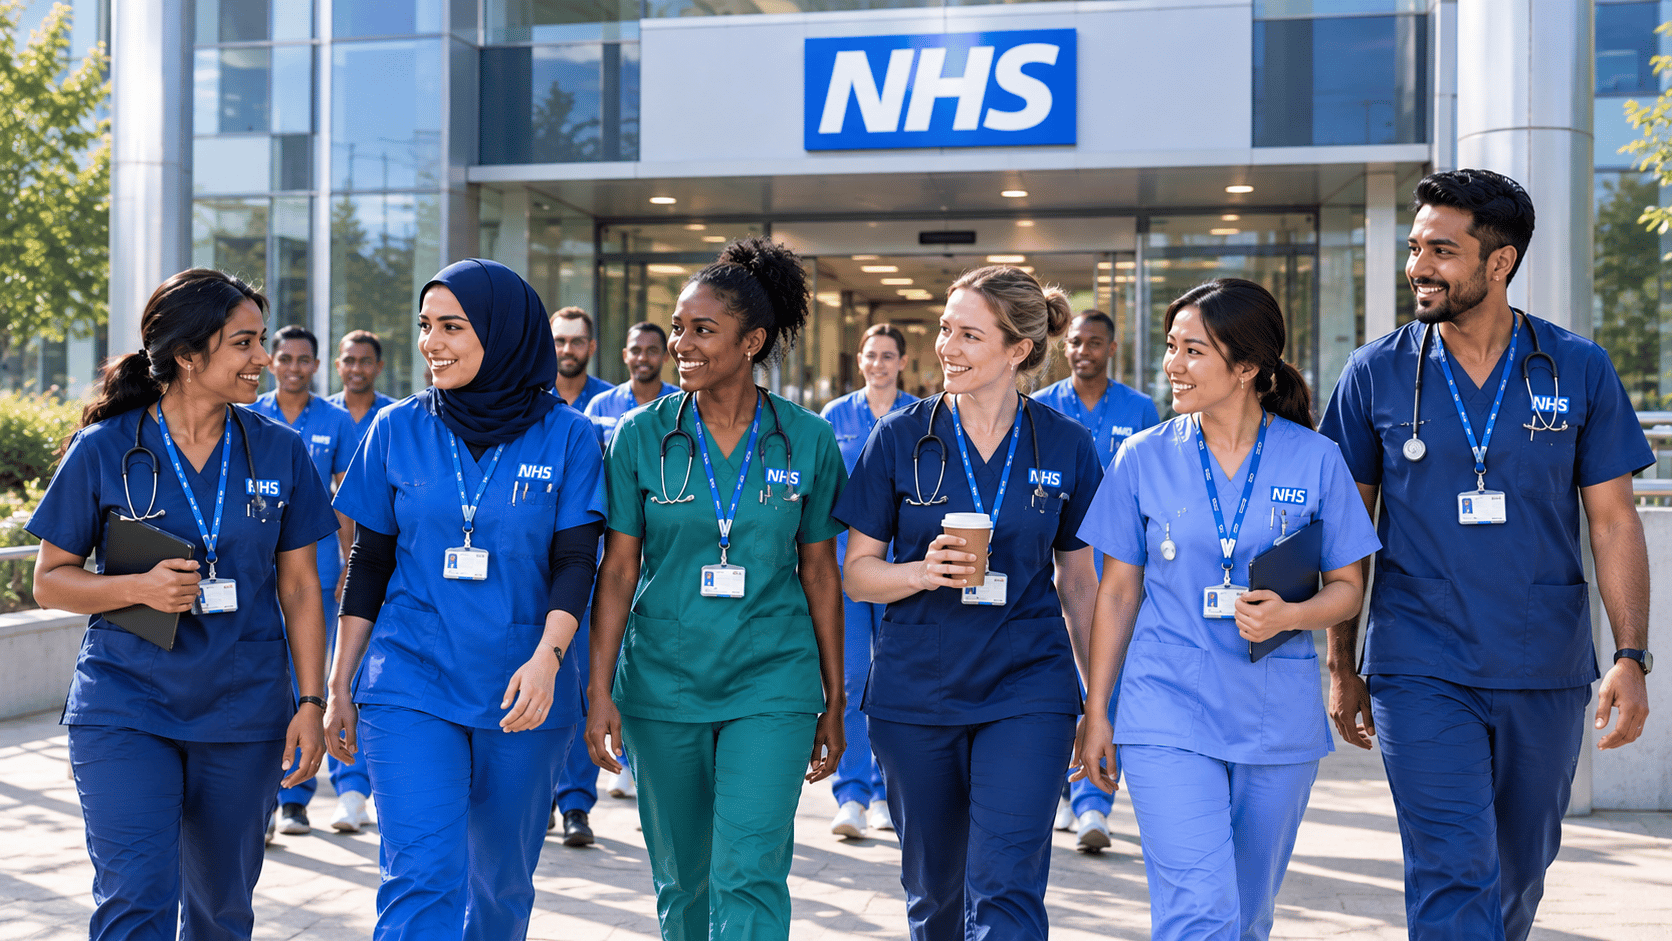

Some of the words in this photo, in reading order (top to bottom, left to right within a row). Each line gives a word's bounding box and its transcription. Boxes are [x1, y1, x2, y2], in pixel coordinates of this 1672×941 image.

[818, 42, 1060, 134] NHS
[1533, 396, 1568, 412] NHS
[517, 464, 553, 480] NHS
[767, 468, 799, 485] NHS
[1030, 470, 1061, 486] NHS
[248, 479, 279, 495] NHS
[1272, 487, 1306, 504] NHS
